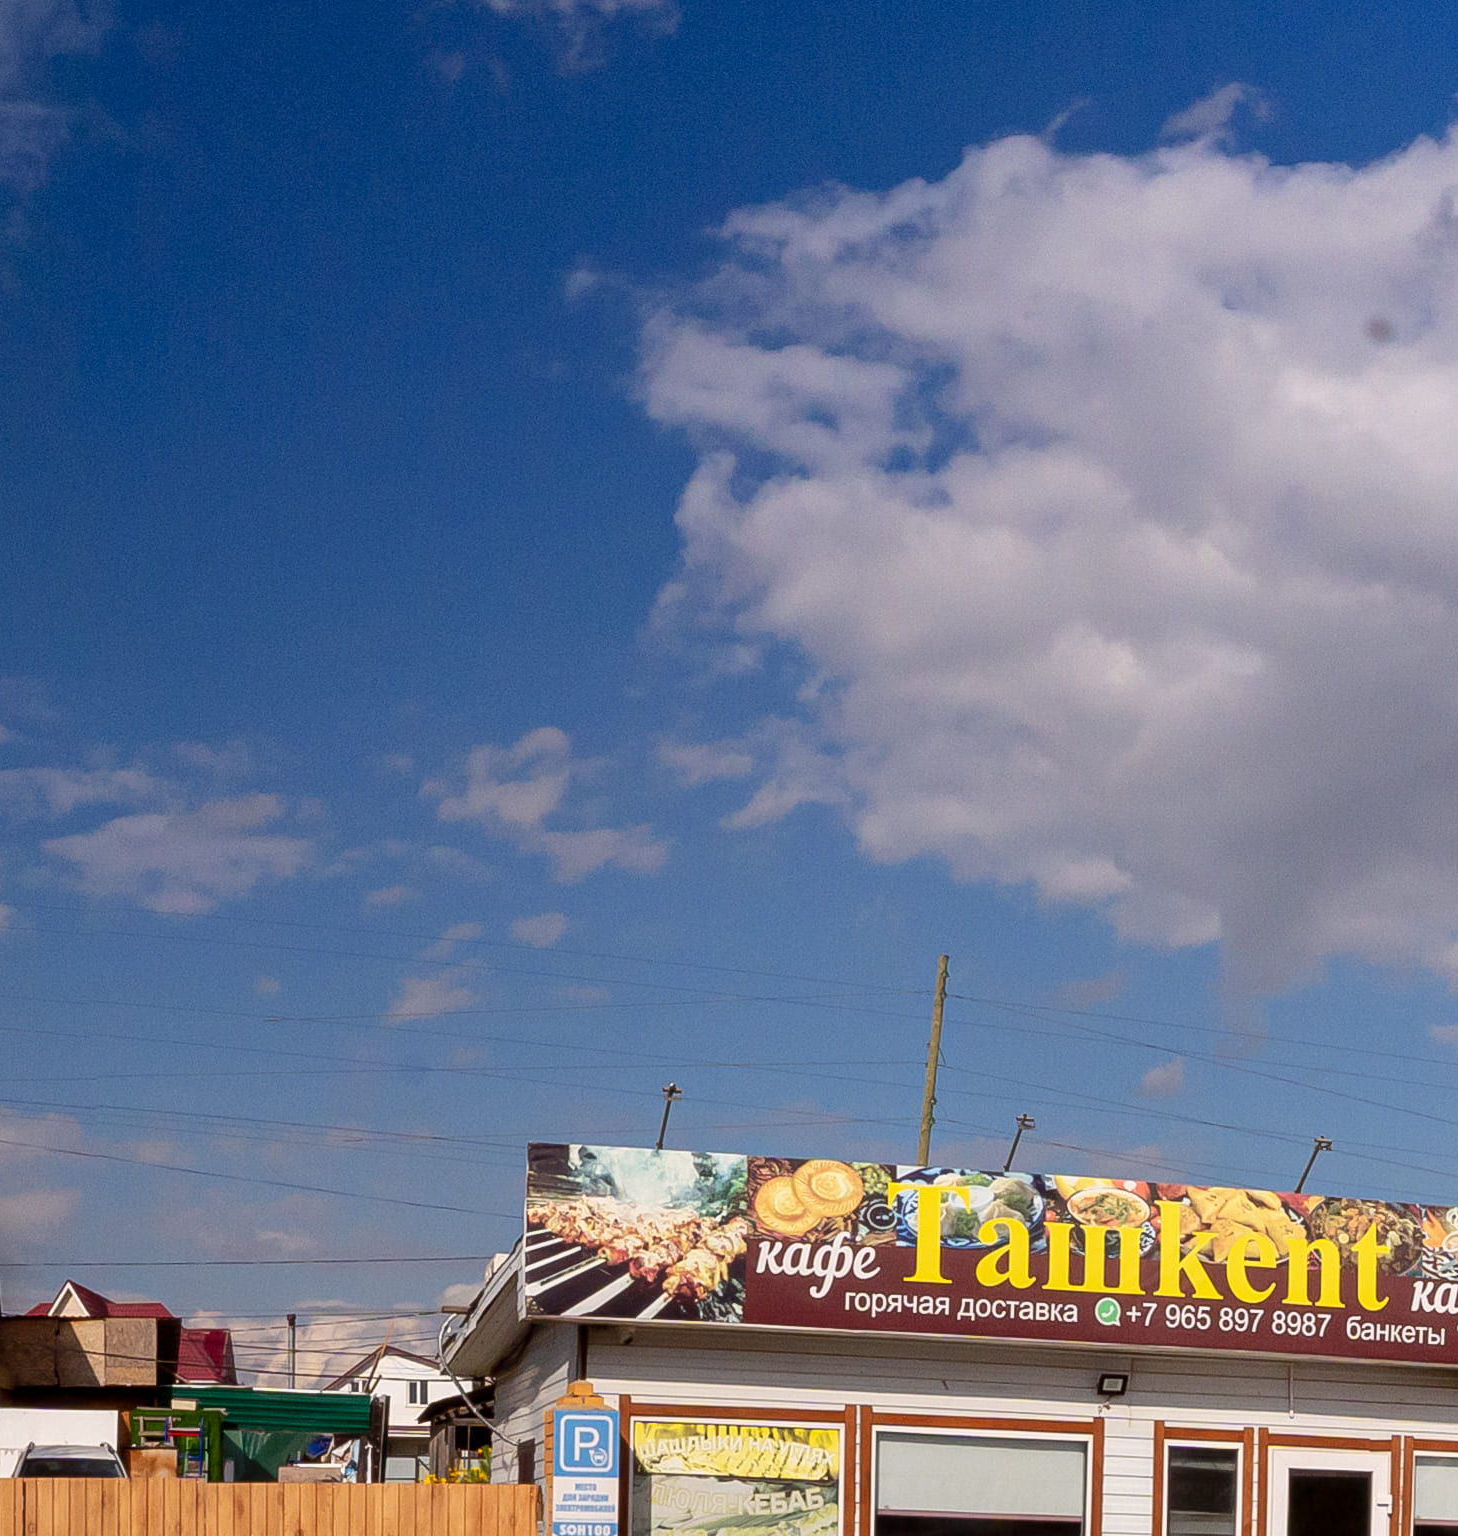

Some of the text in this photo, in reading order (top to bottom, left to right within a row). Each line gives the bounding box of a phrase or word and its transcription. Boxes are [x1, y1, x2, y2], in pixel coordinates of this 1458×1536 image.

[756, 1232, 881, 1298] кафе
[844, 1291, 1446, 1346] горячая доставка +7 965 897 8987 банкеты
[574, 1427, 600, 1461] P
[639, 1436, 743, 1458] ШАШЛЫКИ
[750, 1438, 774, 1452] НА
[651, 1484, 824, 1516] ЛЮЛЯ-КЕБАБ
